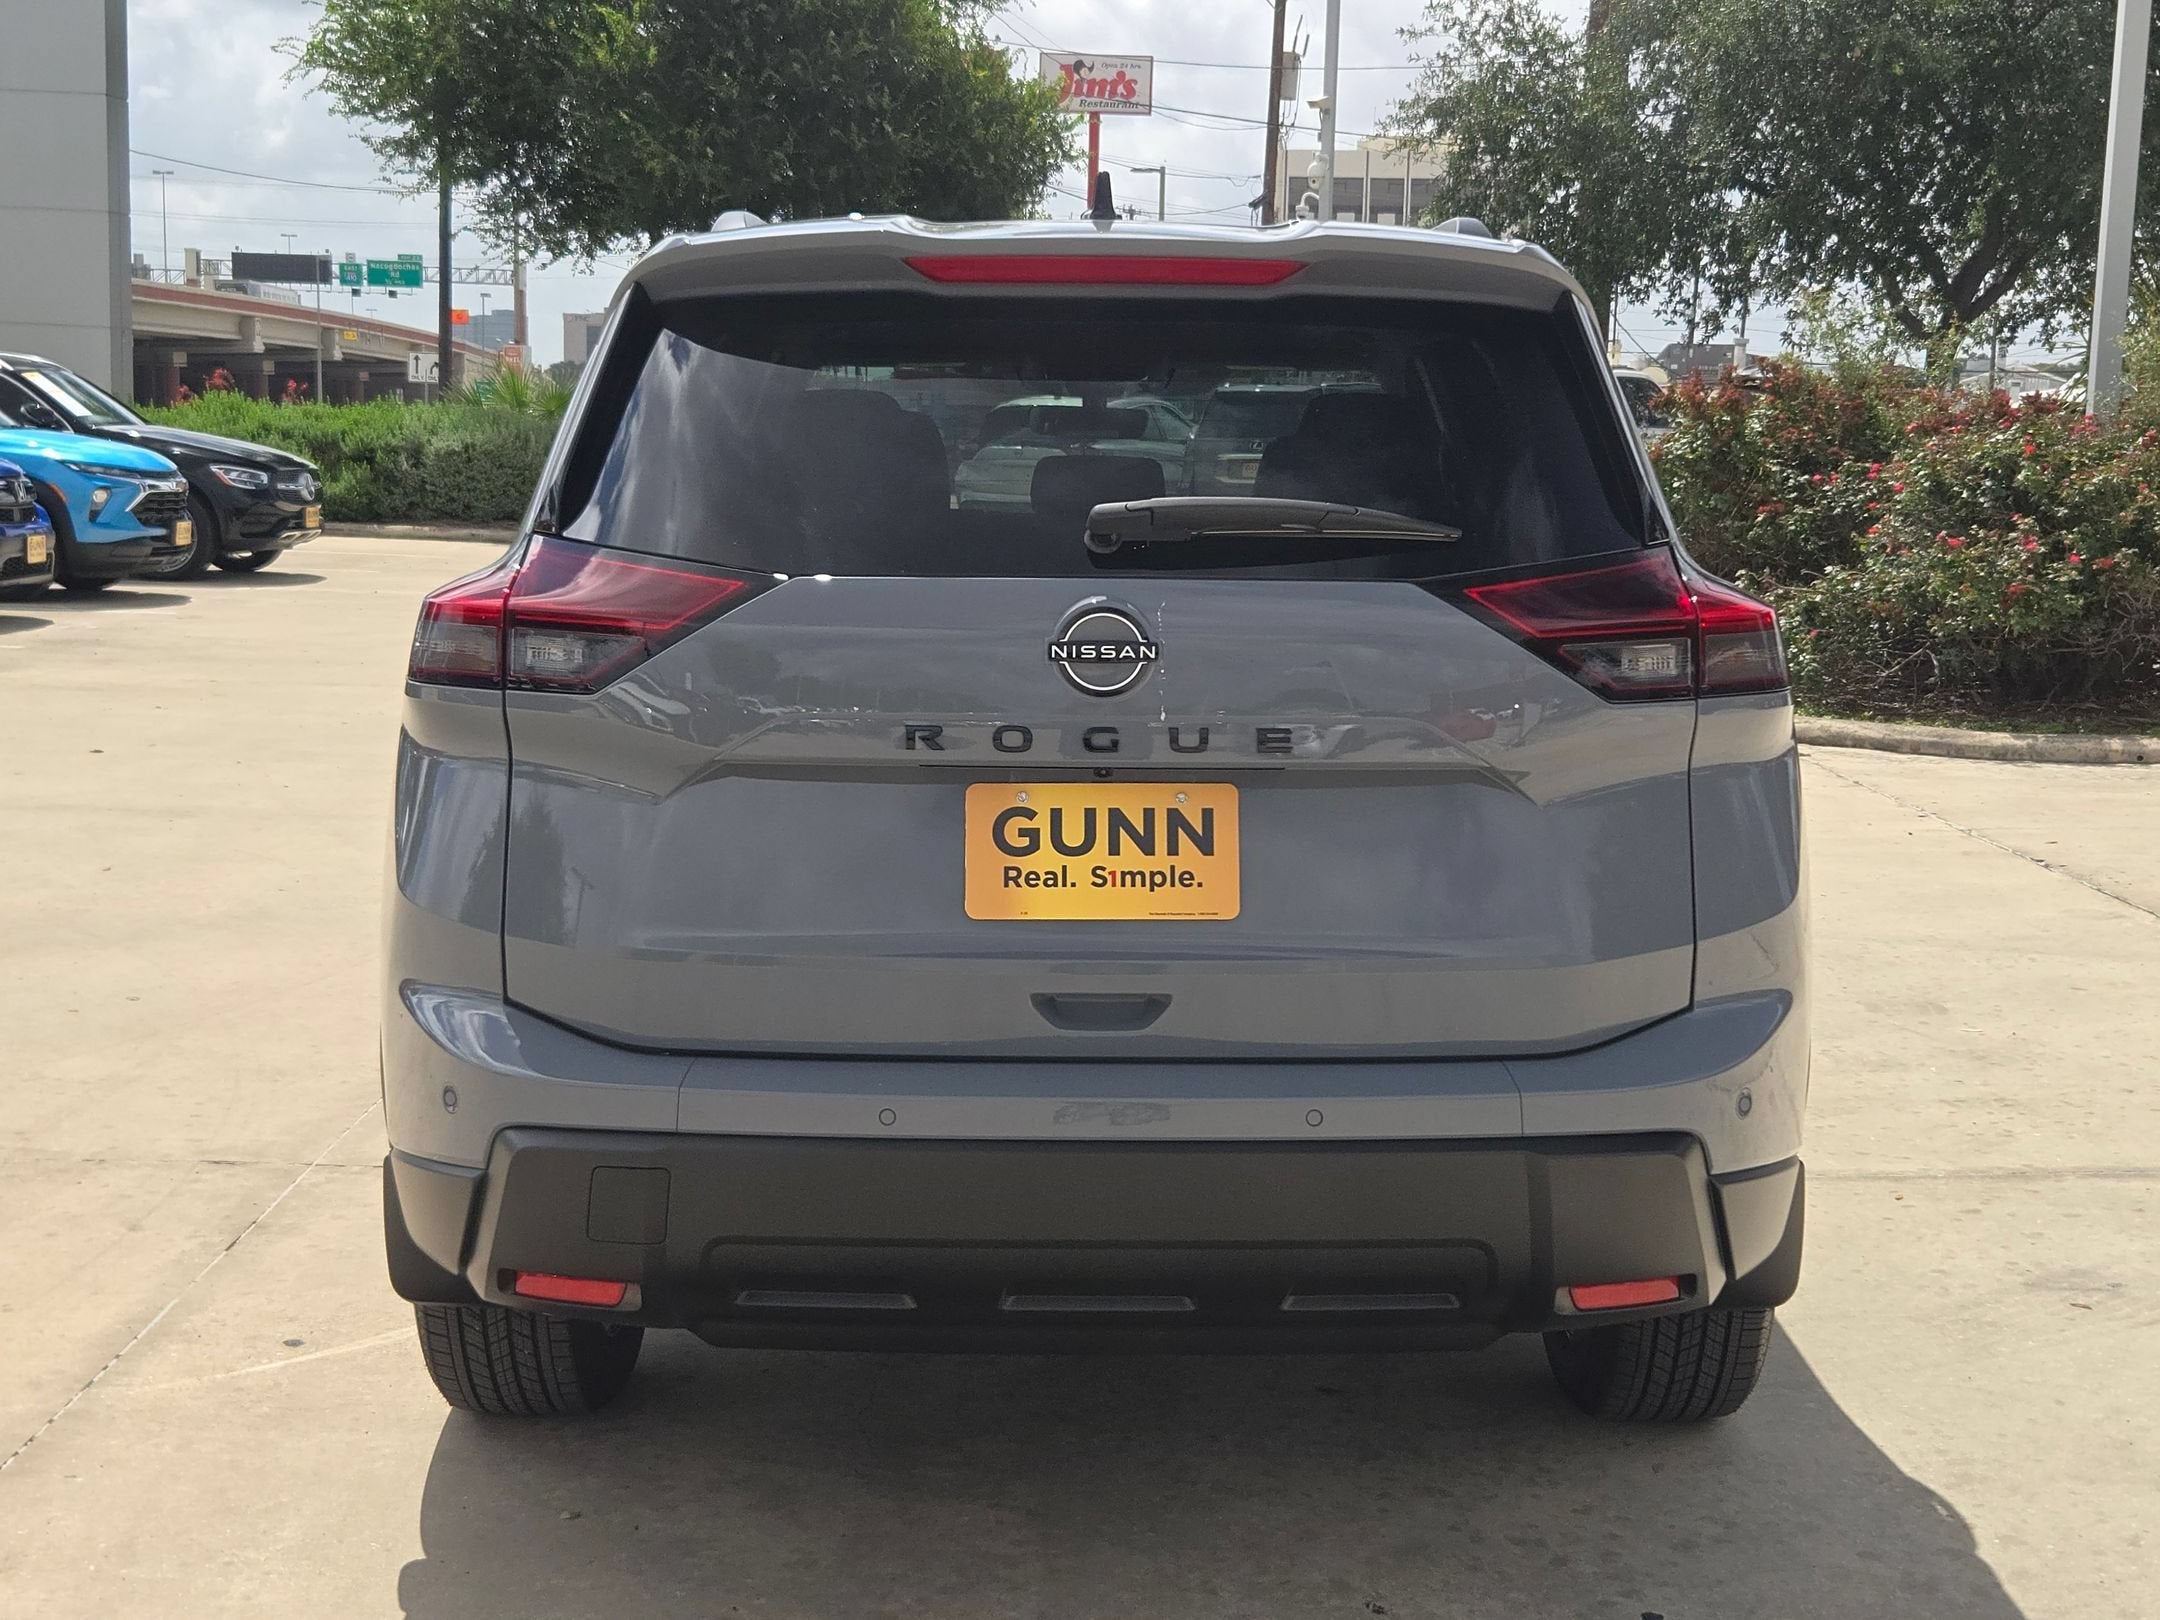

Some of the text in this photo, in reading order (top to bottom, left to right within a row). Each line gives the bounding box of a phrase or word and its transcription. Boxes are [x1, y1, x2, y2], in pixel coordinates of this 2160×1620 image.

[1101, 61, 1118, 70] Open
[1058, 63, 1138, 104] Jim's
[1079, 99, 1139, 110] Restaurant
[1050, 644, 1157, 660] NISSAN
[905, 724, 1294, 754] ROGUE
[991, 806, 1215, 857] GUNN
[1003, 865, 1077, 888] Real.
